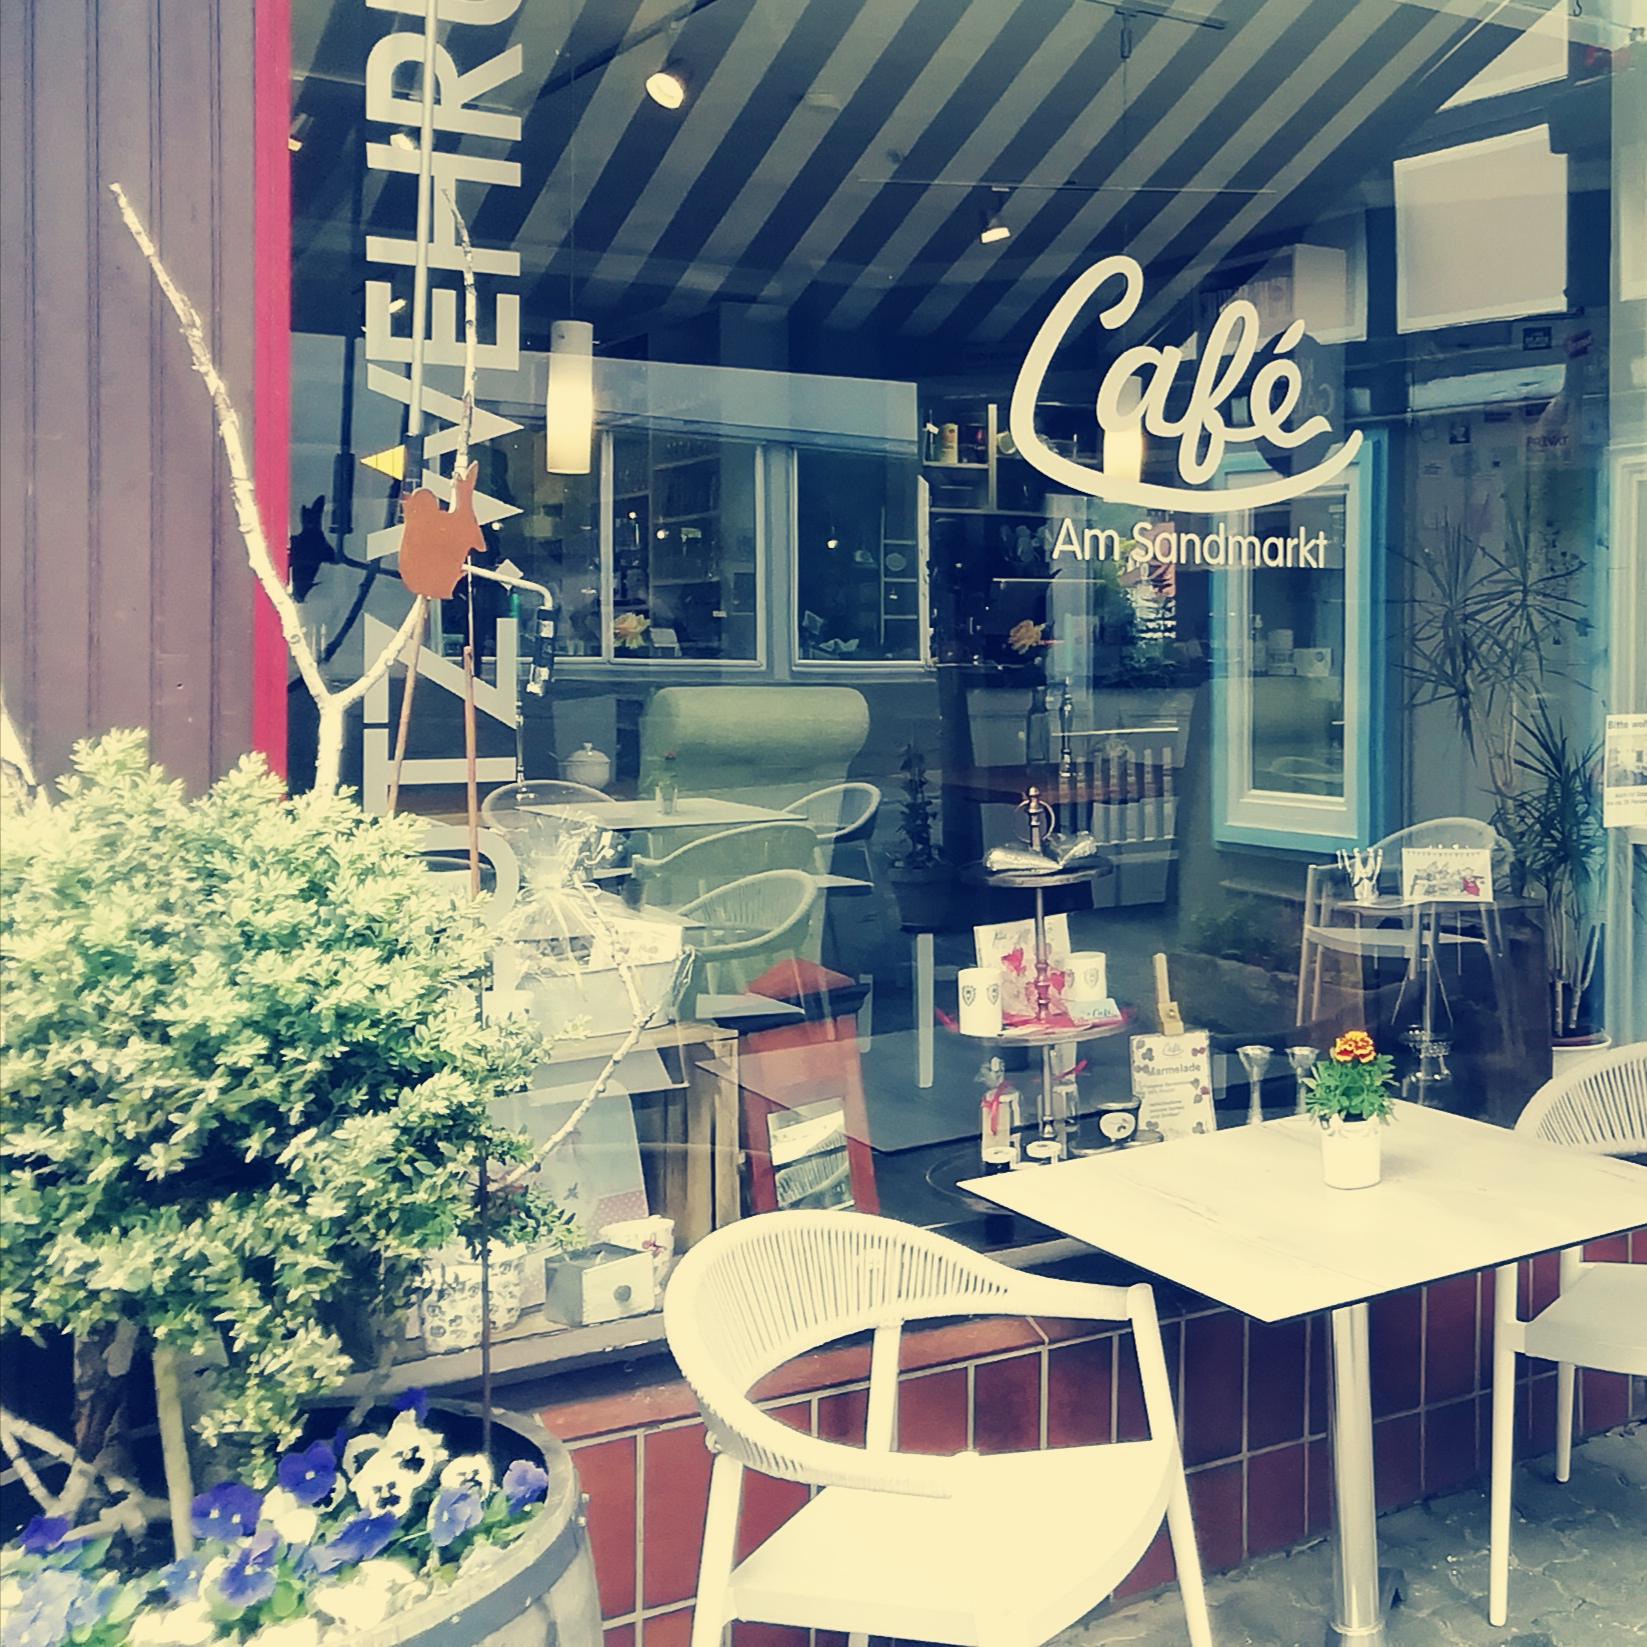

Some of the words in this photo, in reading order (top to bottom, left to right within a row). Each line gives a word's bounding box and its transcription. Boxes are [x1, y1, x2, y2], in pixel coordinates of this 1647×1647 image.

[365, 0, 524, 562] WEHR
[1009, 255, 1364, 513] Café
[1051, 517, 1120, 561] Am
[1131, 521, 1328, 569] Sandmarkt
